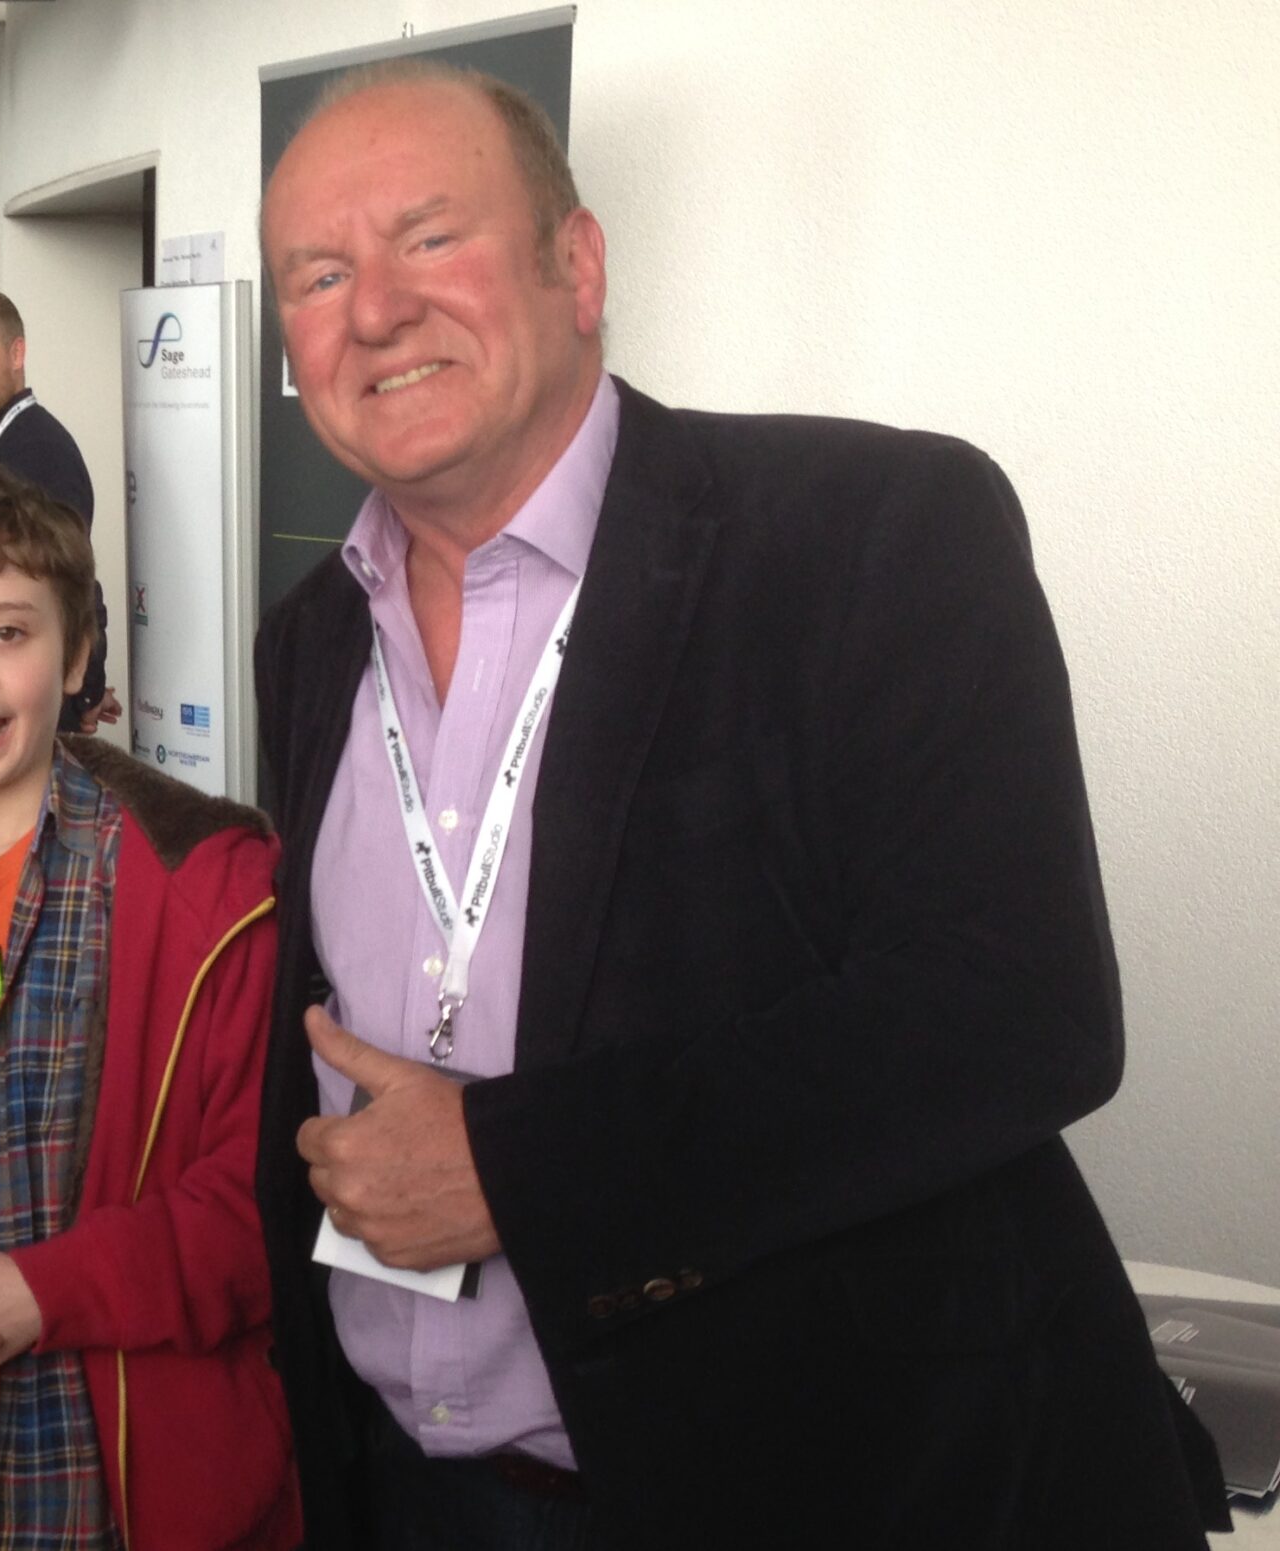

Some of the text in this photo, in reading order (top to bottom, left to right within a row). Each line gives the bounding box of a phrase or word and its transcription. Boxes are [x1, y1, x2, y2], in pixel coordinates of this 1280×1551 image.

[161, 349, 184, 365] Sage
[161, 366, 211, 380] Gateshead
[511, 687, 548, 768] PitbullStudio
[472, 823, 503, 909] PitbullStudio
